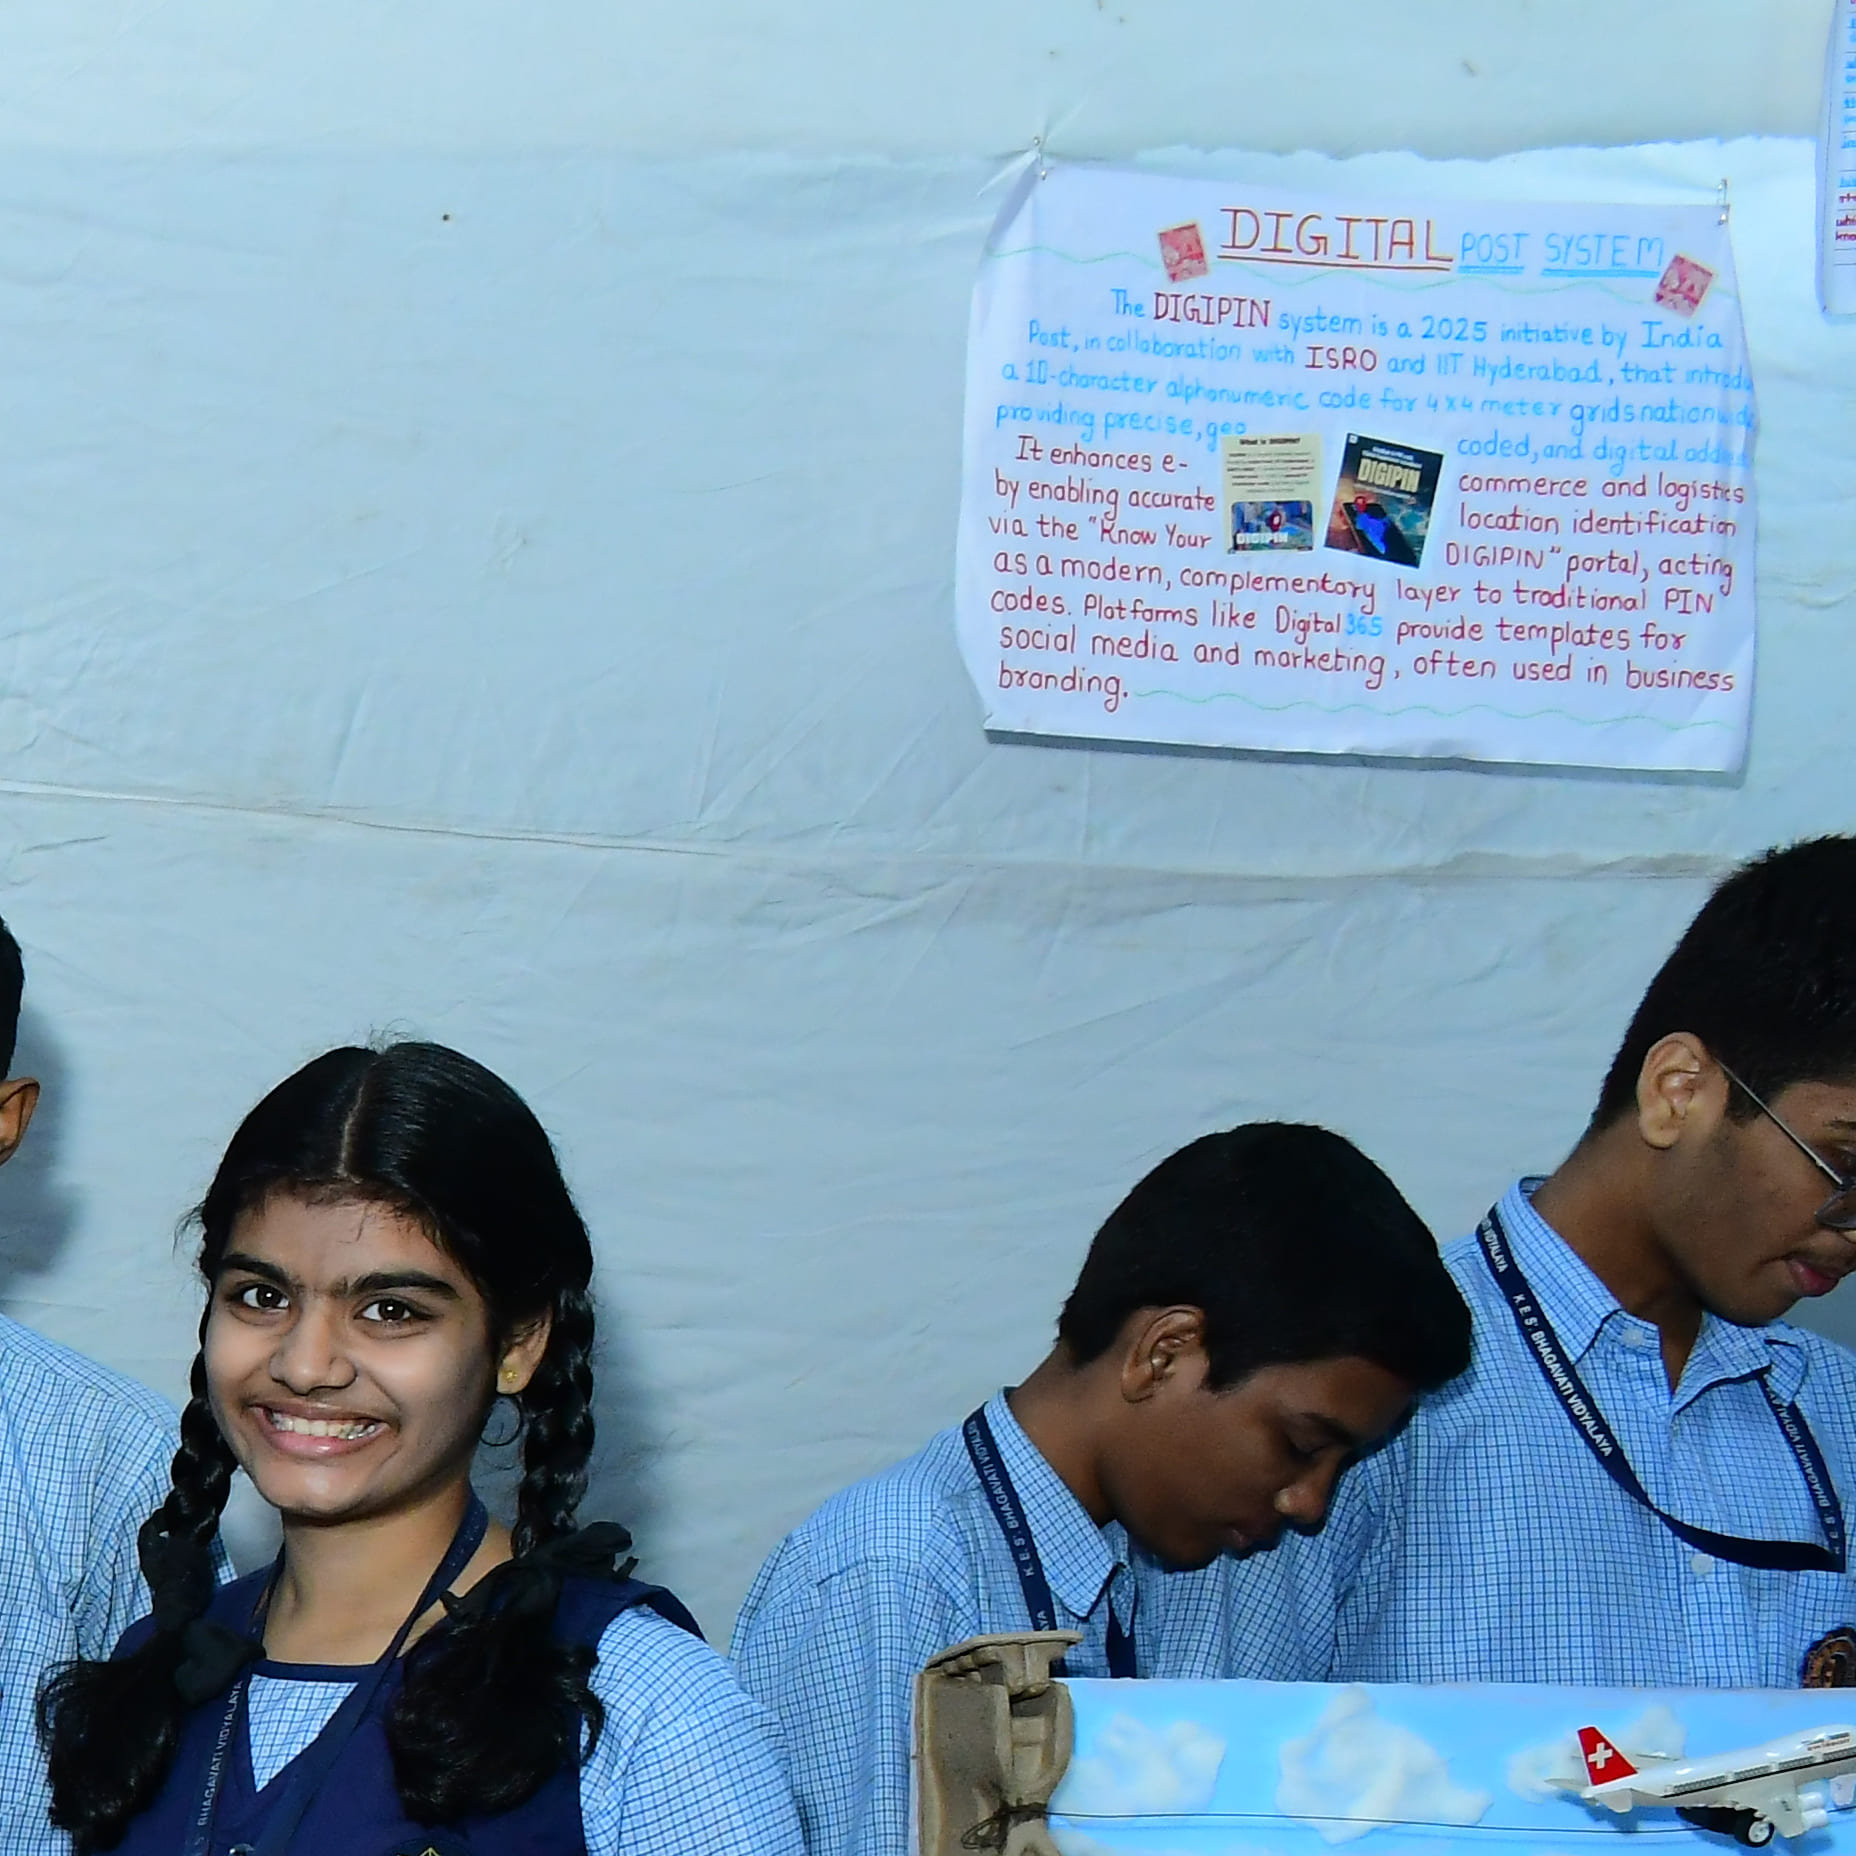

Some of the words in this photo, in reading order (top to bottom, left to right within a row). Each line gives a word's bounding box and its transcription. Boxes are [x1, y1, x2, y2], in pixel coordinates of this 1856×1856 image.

[1220, 207, 1454, 263] DIGITAL
[1460, 232, 1530, 264] POST
[1545, 232, 1664, 268] SYSTEM
[1110, 288, 1145, 318] The
[1153, 292, 1270, 328] DIGIPIN
[1278, 306, 1362, 341] system
[1371, 314, 1389, 335] is
[1397, 323, 1413, 339] a
[1421, 315, 1488, 342] 2025
[1501, 323, 1593, 345] initiative
[1602, 323, 1628, 359] by
[1641, 320, 1723, 349] India
[1305, 345, 1377, 372] ISRO
[1015, 434, 1043, 462] It
[1050, 445, 1152, 473] enhances
[995, 468, 1020, 509] by
[1029, 476, 1119, 522] enabling
[1128, 486, 1215, 512] accurate
[1357, 458, 1421, 493] DIGIPIN
[1458, 473, 1587, 498] commerce
[1602, 474, 1647, 499] and
[1658, 471, 1744, 512] logistics
[1460, 502, 1559, 535] location
[1573, 509, 1737, 537] identification
[994, 551, 1028, 576] as
[1036, 553, 1053, 576] a
[1061, 556, 1171, 591] modern,
[991, 586, 1072, 617] codes.
[1083, 593, 1198, 627] Platforms
[1211, 600, 1256, 630] like
[1397, 578, 1462, 612] layer
[1475, 579, 1502, 604] to
[1513, 579, 1646, 612] traditional
[1664, 587, 1713, 615] PIN
[999, 624, 1076, 654] social
[1092, 629, 1179, 663] media
[1194, 642, 1239, 666] and
[1397, 616, 1484, 645] provide
[1496, 619, 1630, 655] templates
[1639, 622, 1687, 650] for
[999, 660, 1128, 713] branding.
[1414, 649, 1497, 678] often
[1513, 654, 1572, 681] used
[1587, 665, 1608, 685] in
[1626, 660, 1733, 692] business
[1530, 1330, 1575, 1396] BHAGAVATI
[1566, 1393, 1613, 1457] VIDYALAYA
